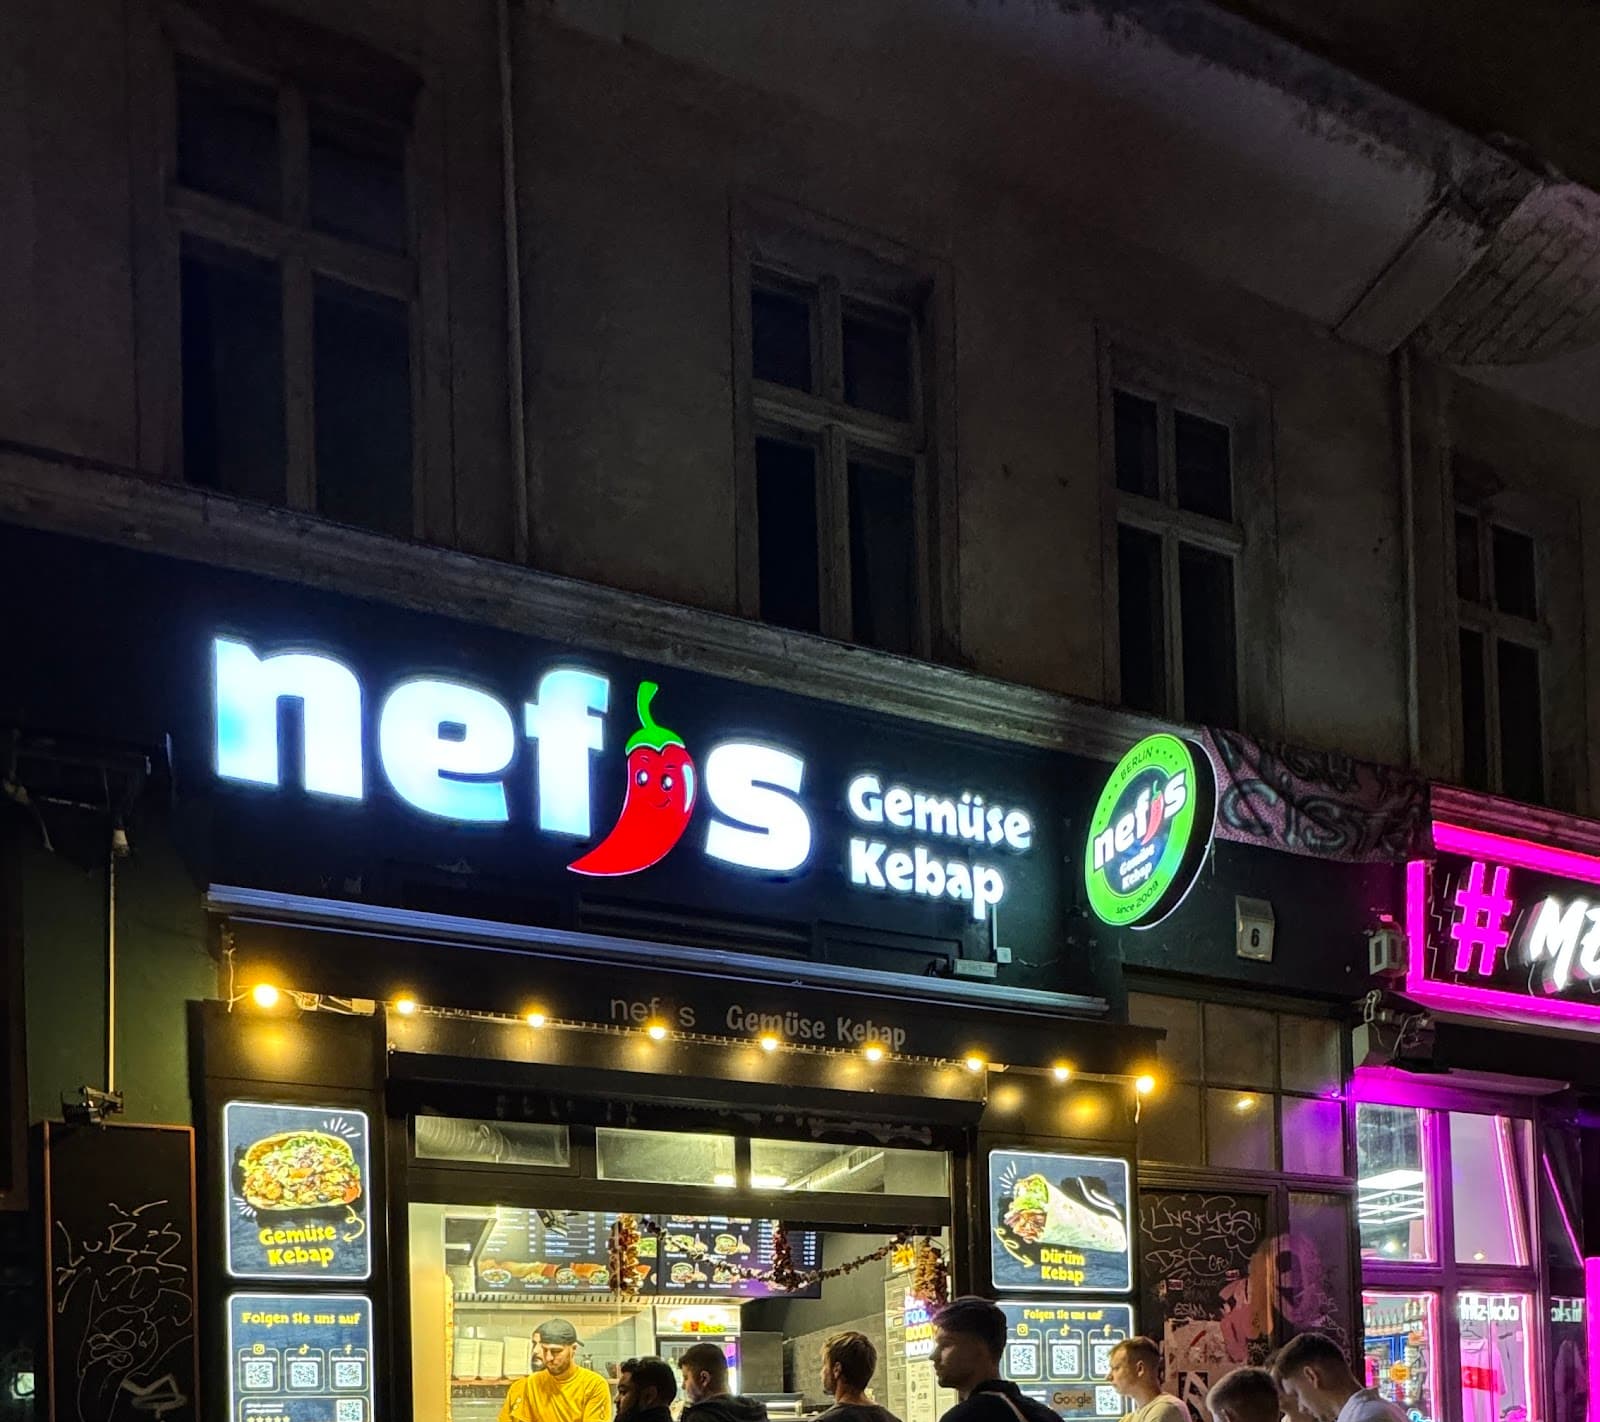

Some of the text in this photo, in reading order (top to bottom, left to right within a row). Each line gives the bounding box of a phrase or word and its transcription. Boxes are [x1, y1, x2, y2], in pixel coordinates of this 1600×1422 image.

[1120, 746, 1155, 780] BERLIN
[848, 775, 1032, 850] Gemüse
[848, 838, 1005, 920] Kebap
[1135, 880, 1159, 908] 2009
[1251, 928, 1260, 948] 6
[726, 1004, 826, 1040] Gemüse
[837, 1016, 907, 1051] Kebap
[258, 1225, 337, 1246] Gemüse
[267, 1246, 335, 1268] Kebap
[1040, 1248, 1086, 1266] Dürüm
[1041, 1265, 1085, 1287] Kebap
[241, 1312, 289, 1328] Folgen
[313, 1314, 336, 1325] uns
[338, 1312, 361, 1325] auf
[1053, 1391, 1093, 1407] Google
